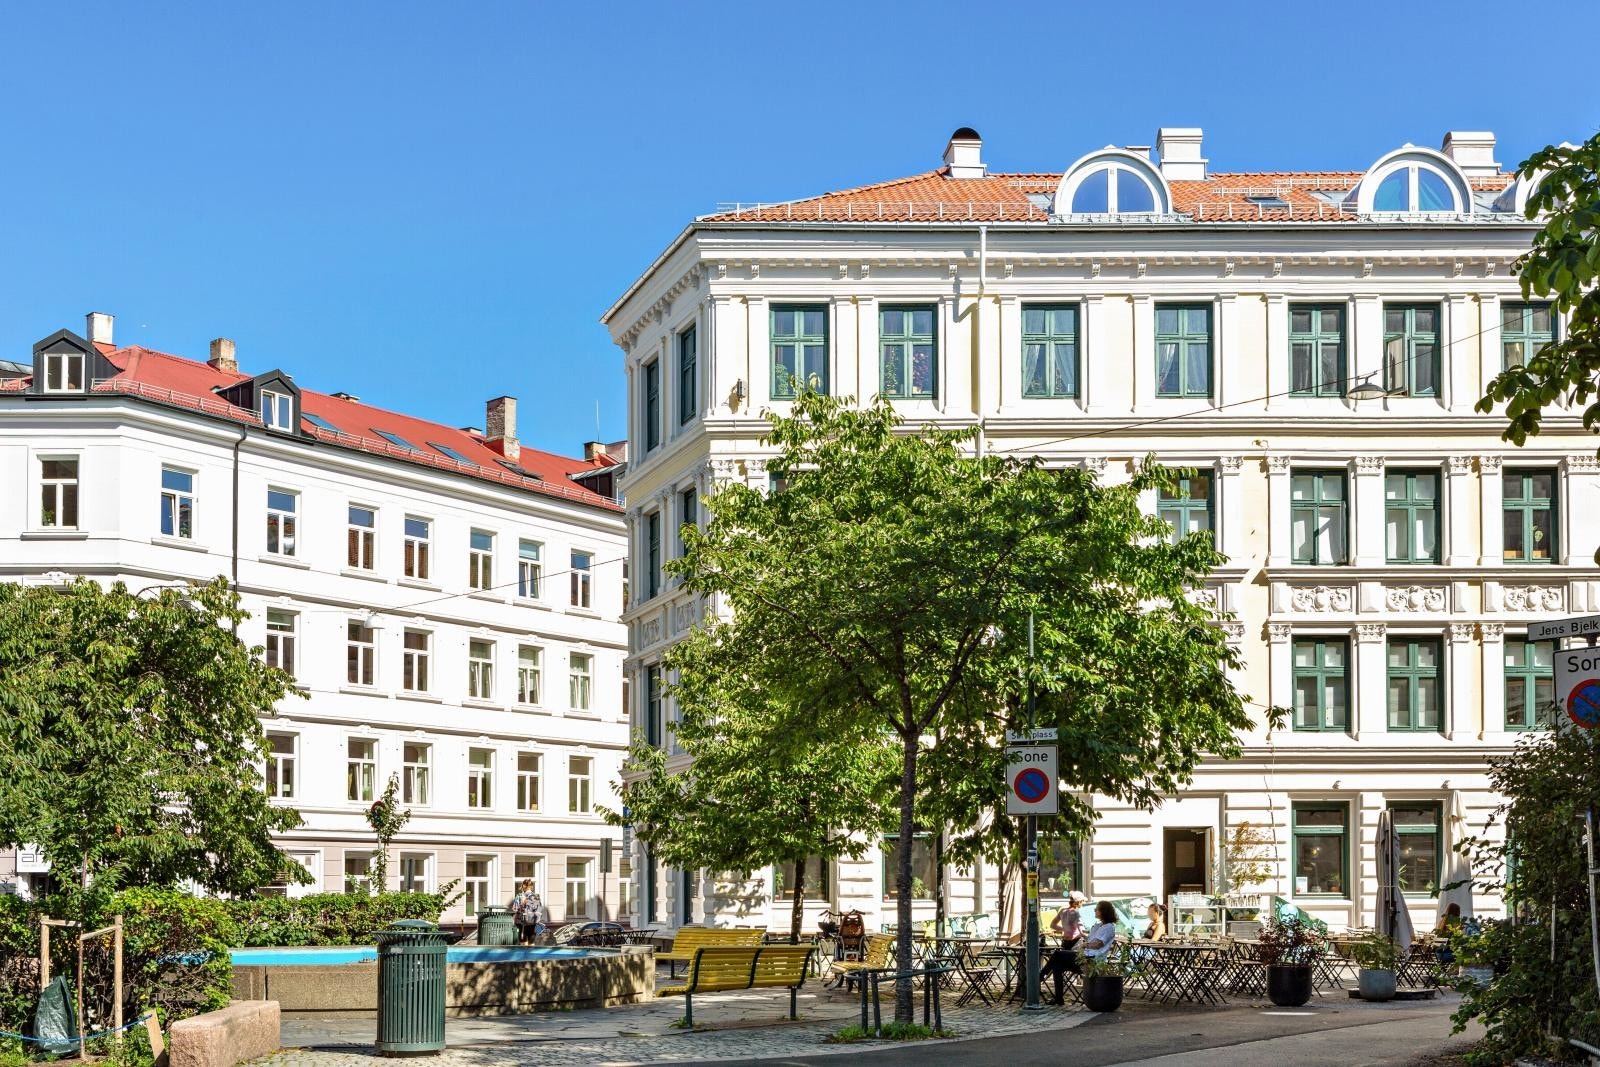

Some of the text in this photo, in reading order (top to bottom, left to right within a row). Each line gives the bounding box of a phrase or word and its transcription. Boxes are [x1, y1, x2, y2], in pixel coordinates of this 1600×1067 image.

[1539, 620, 1599, 636] Jens Bjelk
[1032, 731, 1053, 739] plass
